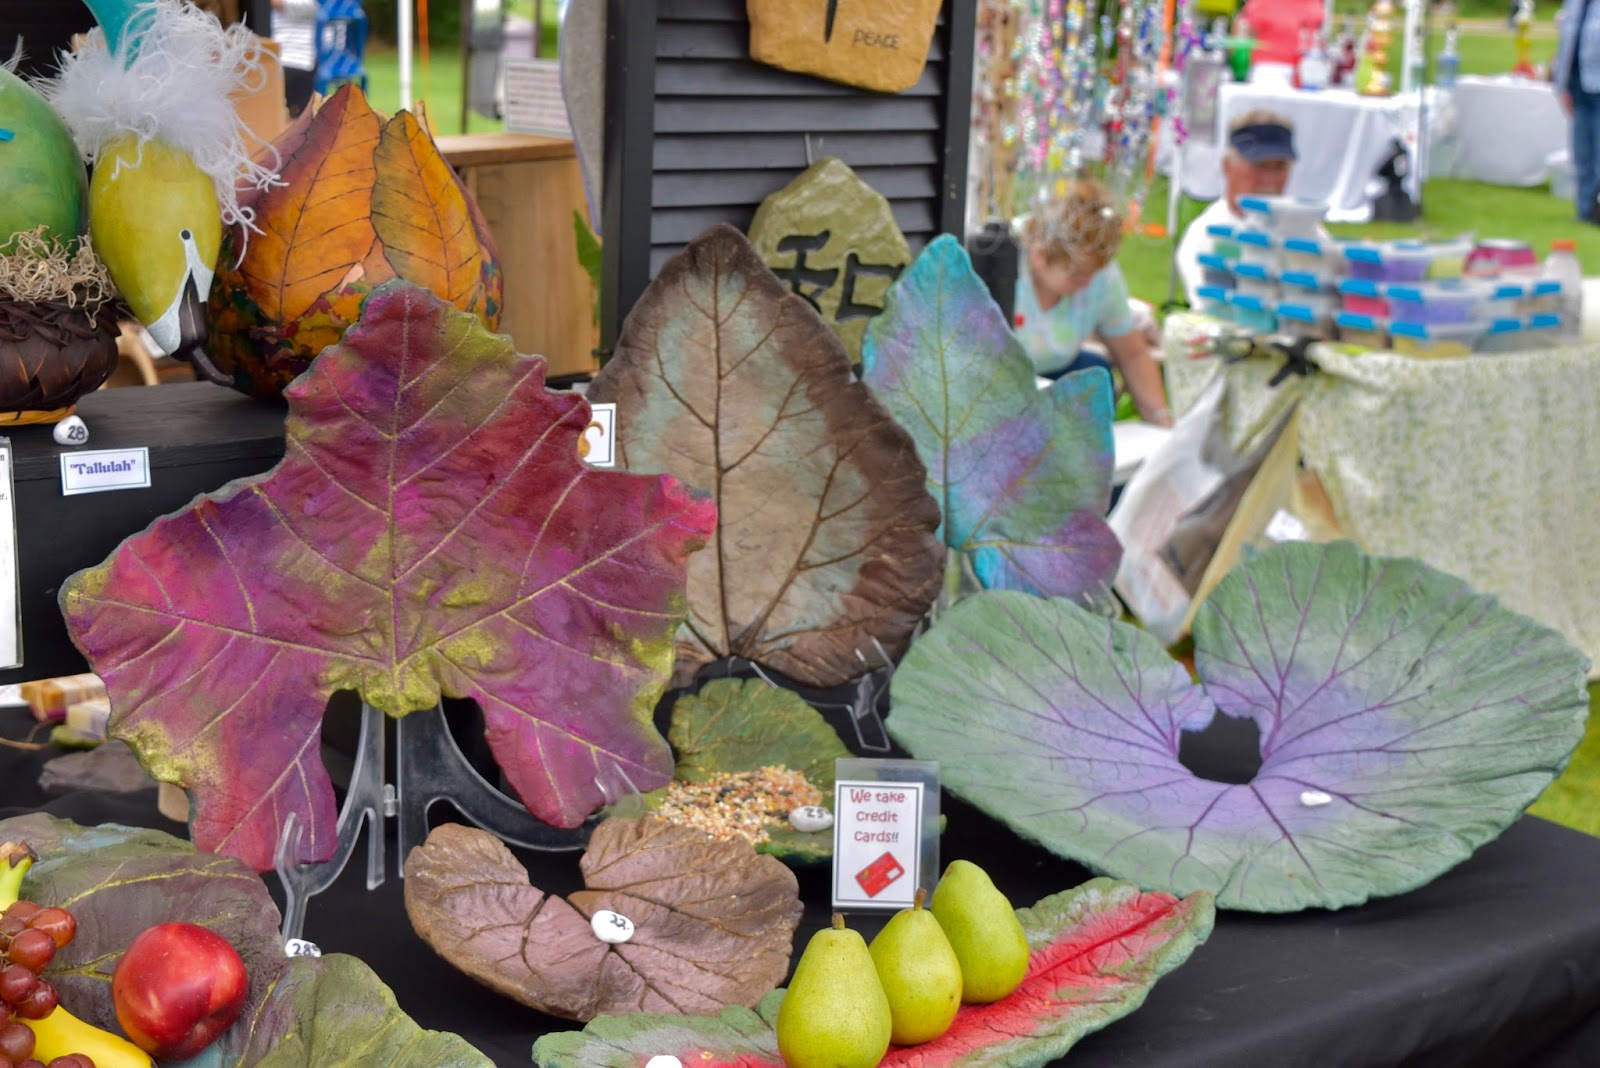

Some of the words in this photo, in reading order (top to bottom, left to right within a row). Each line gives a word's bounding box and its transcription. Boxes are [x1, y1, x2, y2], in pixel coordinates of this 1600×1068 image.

[852, 28, 899, 49] PEACE
[67, 424, 85, 441] 28
[70, 459, 136, 475] "Tallulah"
[850, 788, 872, 803] We
[875, 791, 905, 803] take
[856, 810, 899, 822] Credit
[854, 830, 900, 843] Cards!!
